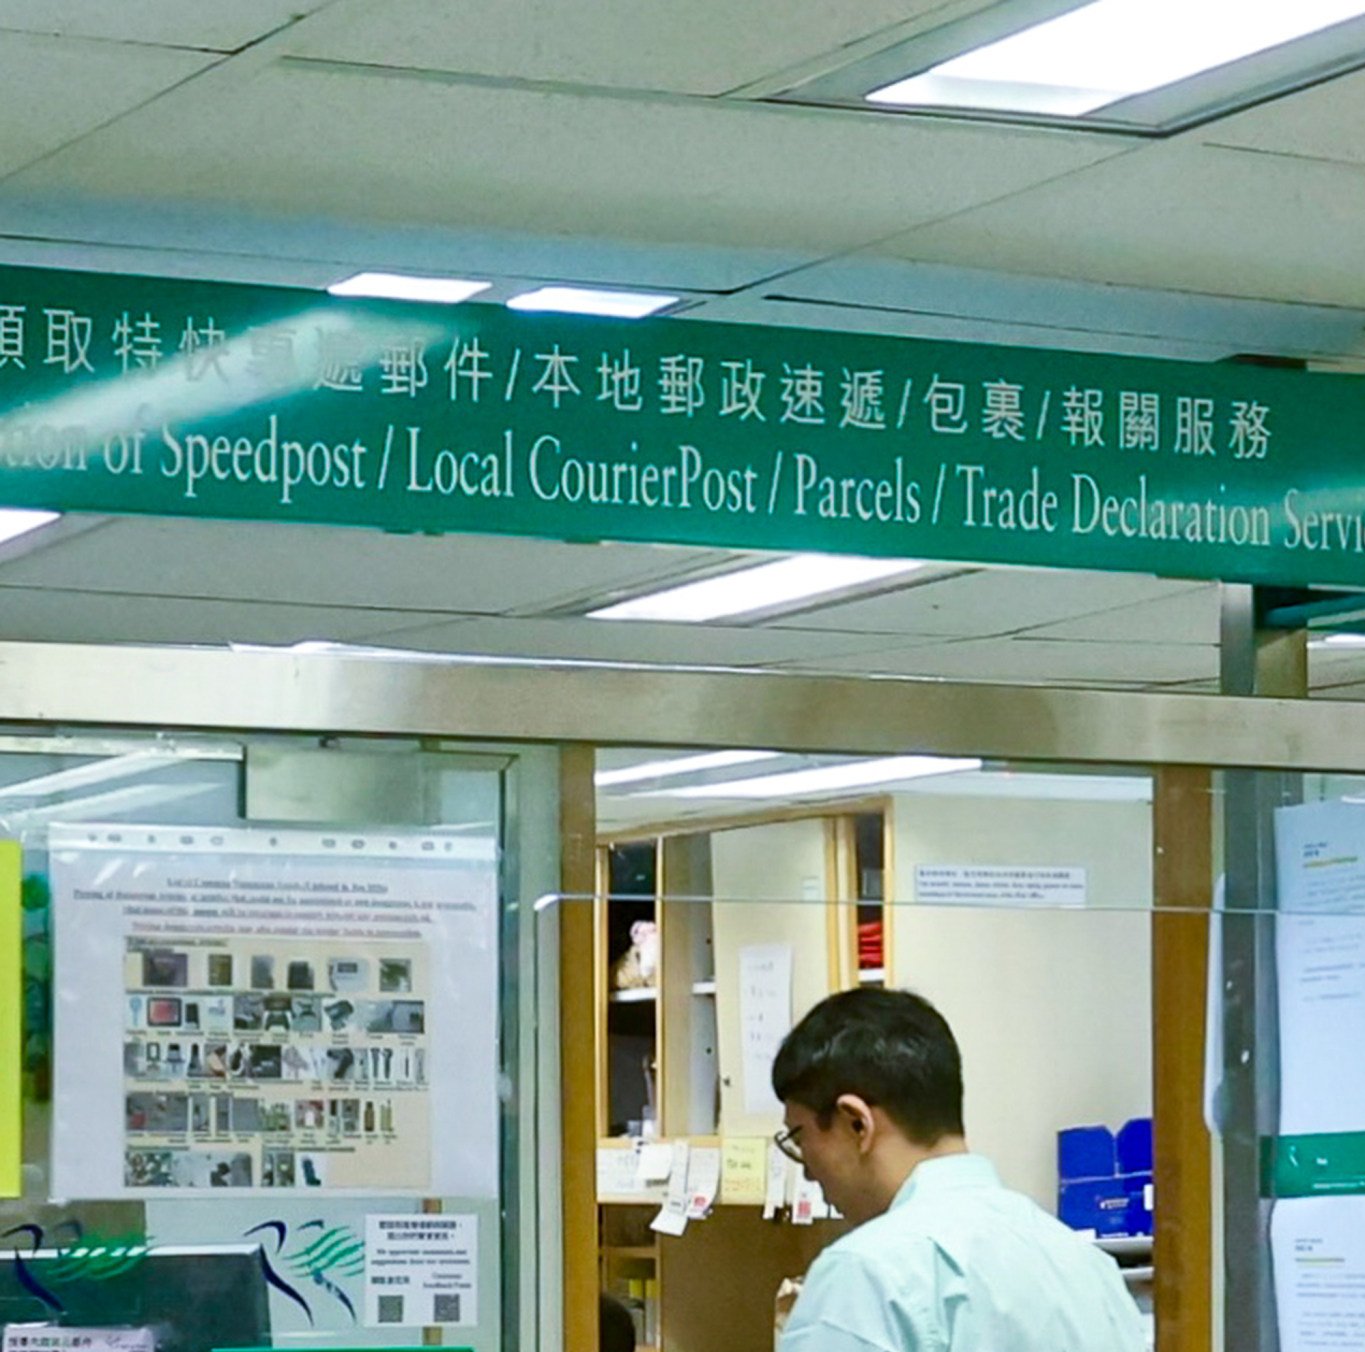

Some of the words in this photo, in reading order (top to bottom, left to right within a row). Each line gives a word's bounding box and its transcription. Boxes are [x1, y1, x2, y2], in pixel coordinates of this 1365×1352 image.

[161, 414, 367, 503] Speedpost
[407, 425, 515, 498] Local
[529, 434, 757, 516] CourierPost
[794, 454, 922, 524] Parcels
[956, 466, 1057, 533] Trade
[1072, 474, 1271, 546] Declaration
